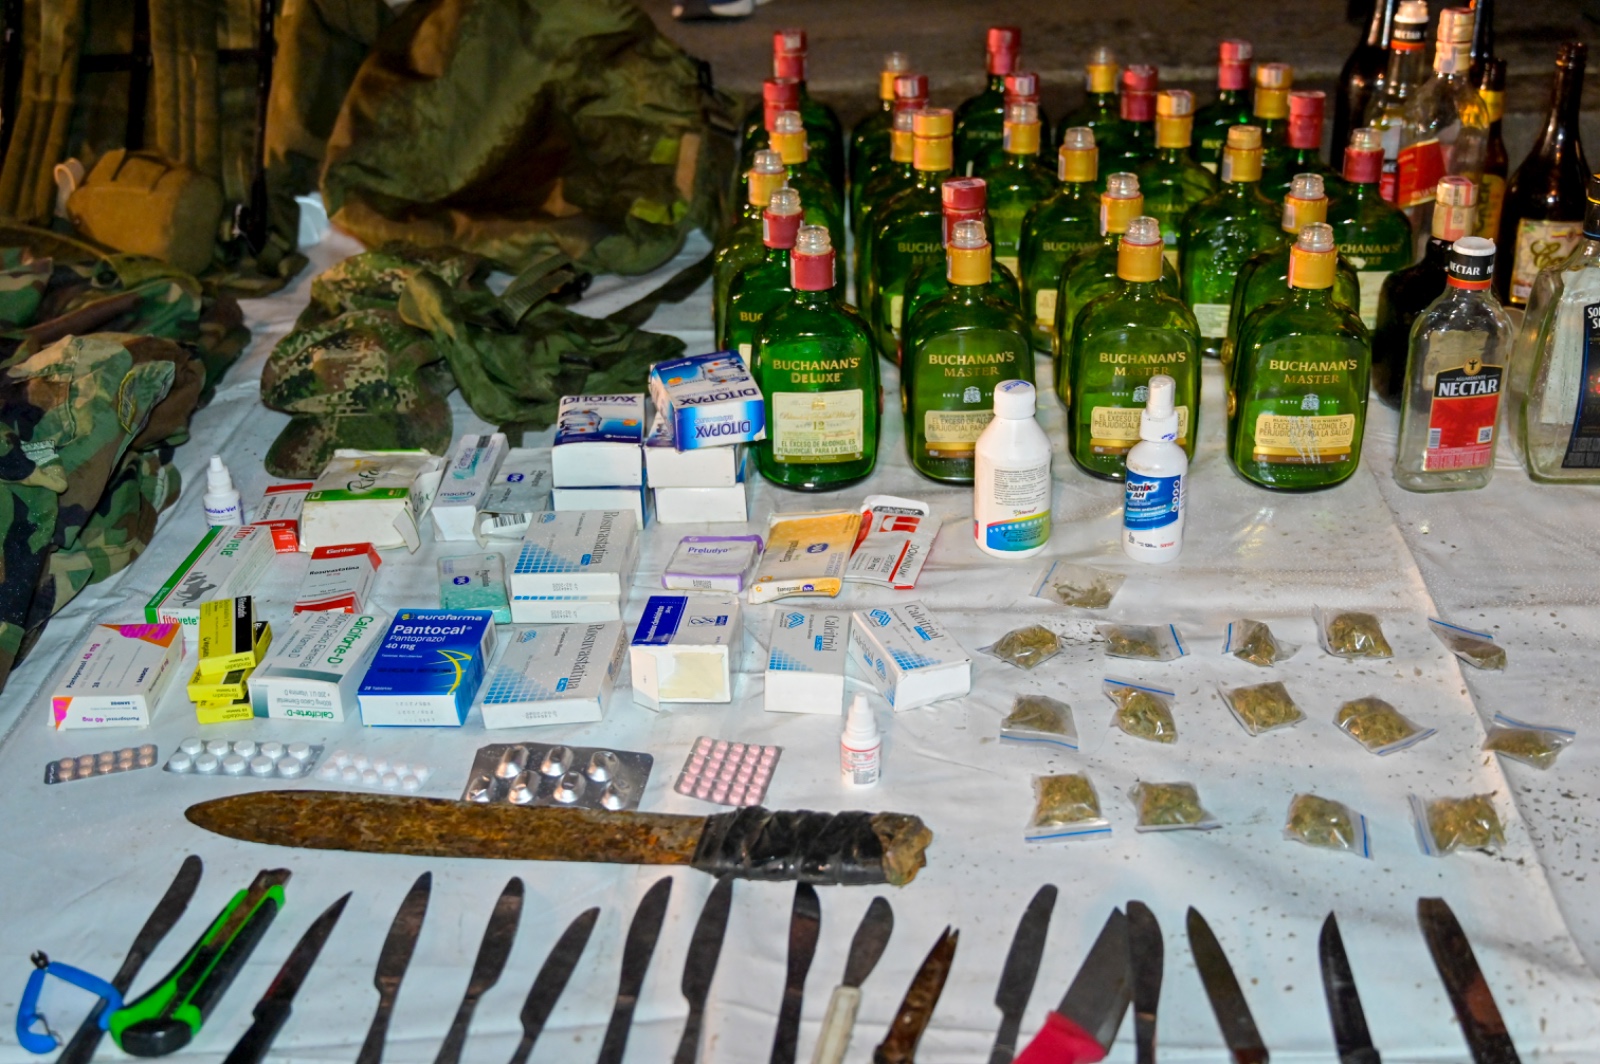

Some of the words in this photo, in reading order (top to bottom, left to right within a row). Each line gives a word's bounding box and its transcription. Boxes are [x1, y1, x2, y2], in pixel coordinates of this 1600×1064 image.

[898, 242, 943, 253] BUCHA
[1450, 261, 1480, 276] NECTAR
[772, 358, 859, 370] BUCHANAN'S
[928, 351, 1015, 365] BUCHANAN'S
[1100, 352, 1186, 364] BUCHANAN'S
[1269, 359, 1357, 371] BUCHANAN'S
[944, 367, 1000, 377] MASTER
[1114, 367, 1170, 376] MASTER
[1284, 374, 1340, 384] MASTER
[1438, 379, 1498, 396] NECTAR
[681, 388, 757, 405] DITOPAX
[696, 421, 750, 438] DITOPAX
[813, 421, 825, 430] 12
[1127, 482, 1152, 491] Sanix
[220, 526, 256, 557] fitovete
[591, 511, 619, 564] Rosuvastatina
[309, 566, 359, 575] Rosuvastatina
[163, 615, 197, 625] fitovete
[905, 604, 944, 640] Calcitriol
[392, 625, 466, 634] Pantocal
[824, 615, 839, 652] Calcitriol
[291, 633, 314, 657] Vitamina
[319, 628, 338, 649] Calcio
[327, 615, 374, 664] Calciforte-D
[299, 645, 326, 668] Elemental
[567, 624, 605, 690] Rosuvastatina
[66, 660, 87, 688] Pantoprazol
[90, 643, 101, 652] mg
[225, 661, 252, 670] Rinotadin
[286, 709, 334, 719] Calciforte-D
